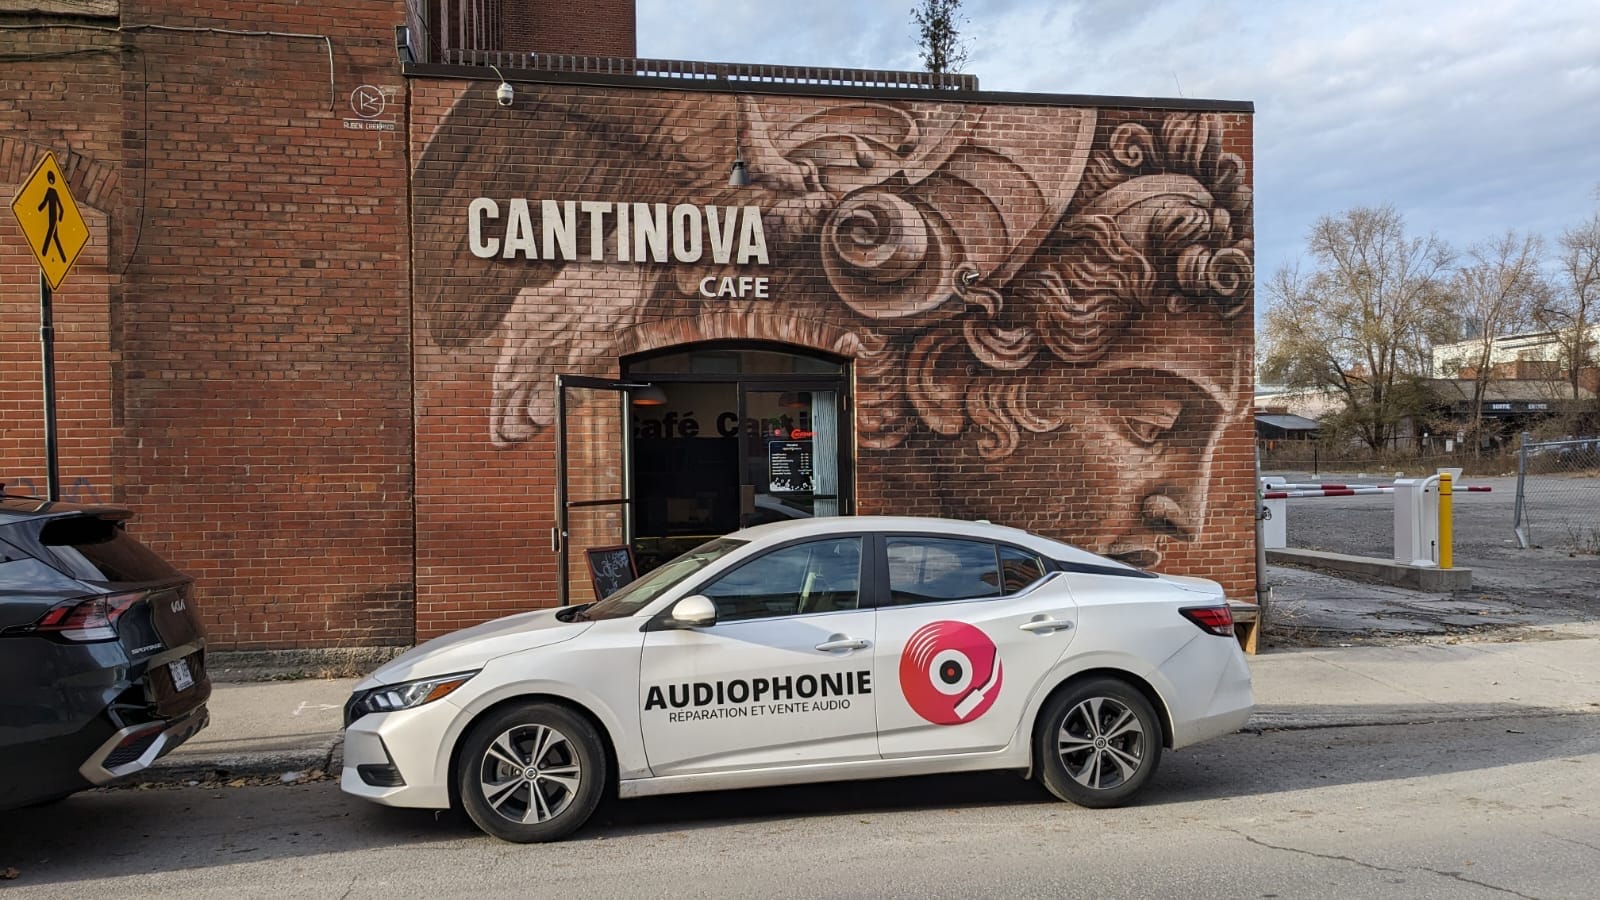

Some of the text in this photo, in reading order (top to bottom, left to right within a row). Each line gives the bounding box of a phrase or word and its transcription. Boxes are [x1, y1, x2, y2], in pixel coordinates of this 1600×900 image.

[468, 197, 770, 265] CANTINOVA
[699, 276, 770, 299] CAFE
[170, 598, 186, 613] KIA
[644, 670, 872, 711] AUDIOPHONIE
[669, 698, 851, 723] RÉPARATION ET VENTE AUDIO
